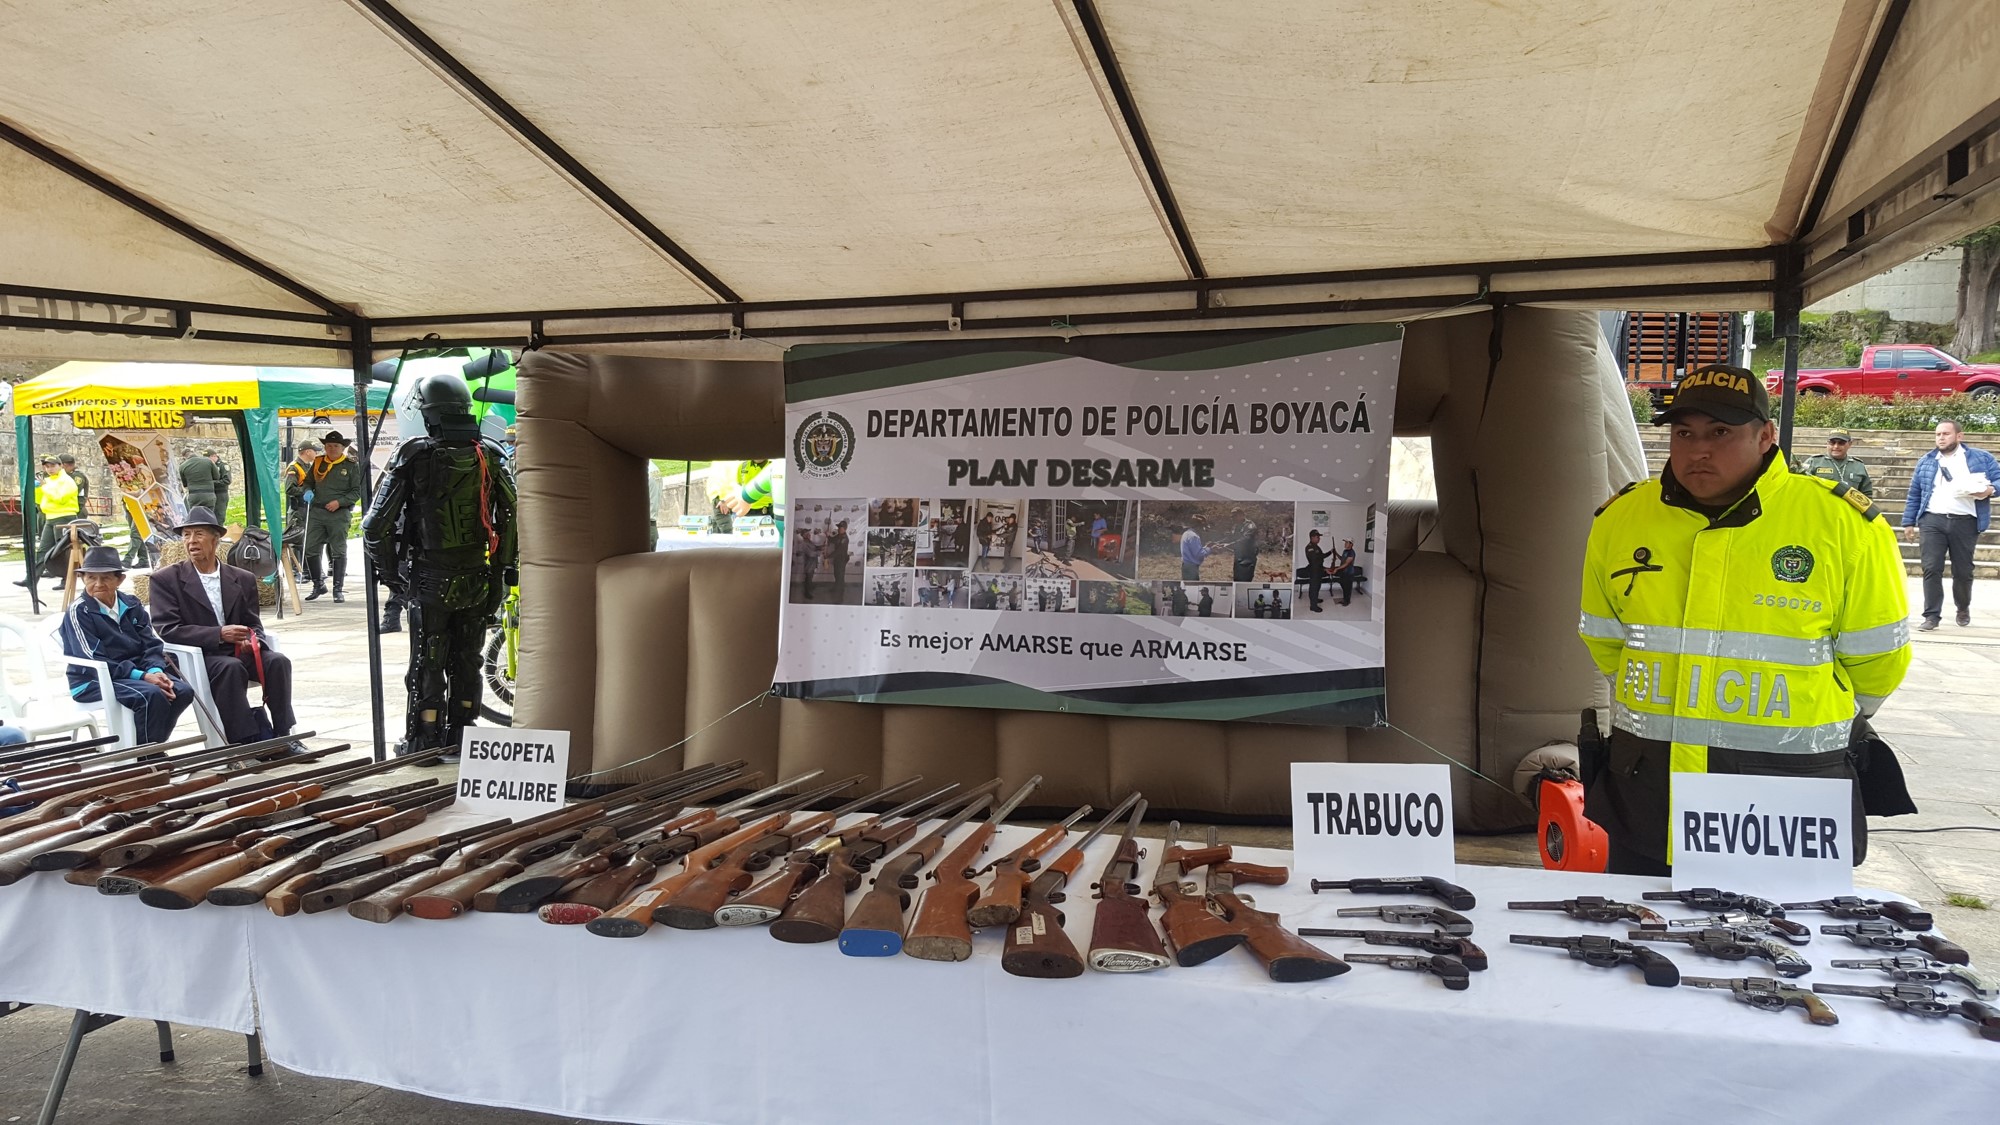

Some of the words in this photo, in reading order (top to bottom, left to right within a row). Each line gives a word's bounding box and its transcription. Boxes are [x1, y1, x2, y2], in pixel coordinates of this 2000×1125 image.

[1677, 371, 1749, 396] POLICIA
[32, 397, 118, 410] carabineros
[122, 399, 131, 408] y
[180, 395, 239, 406] METUN
[866, 406, 1073, 438] DEPARTAMENTO
[1081, 406, 1117, 436] DE
[1126, 396, 1240, 436] POLICÍA
[1250, 392, 1371, 435] BOYACÁ
[72, 409, 186, 429] CARABINEROS
[948, 459, 1038, 487] PLAN
[1046, 458, 1215, 488] DESARME
[1753, 593, 1823, 613] 269078
[880, 629, 901, 648] Es
[907, 632, 973, 654] mejor
[979, 633, 1073, 655] AMARSE
[1079, 641, 1123, 660] que
[1129, 639, 1247, 662] ARMARSE
[1623, 658, 1791, 719] POLICIA
[469, 740, 555, 763] ESCOPETA
[460, 778, 482, 798] DE
[486, 780, 558, 803] CALIBRE
[1307, 792, 1444, 837] TRABUCO
[1684, 803, 1840, 860] REVÓLVER
